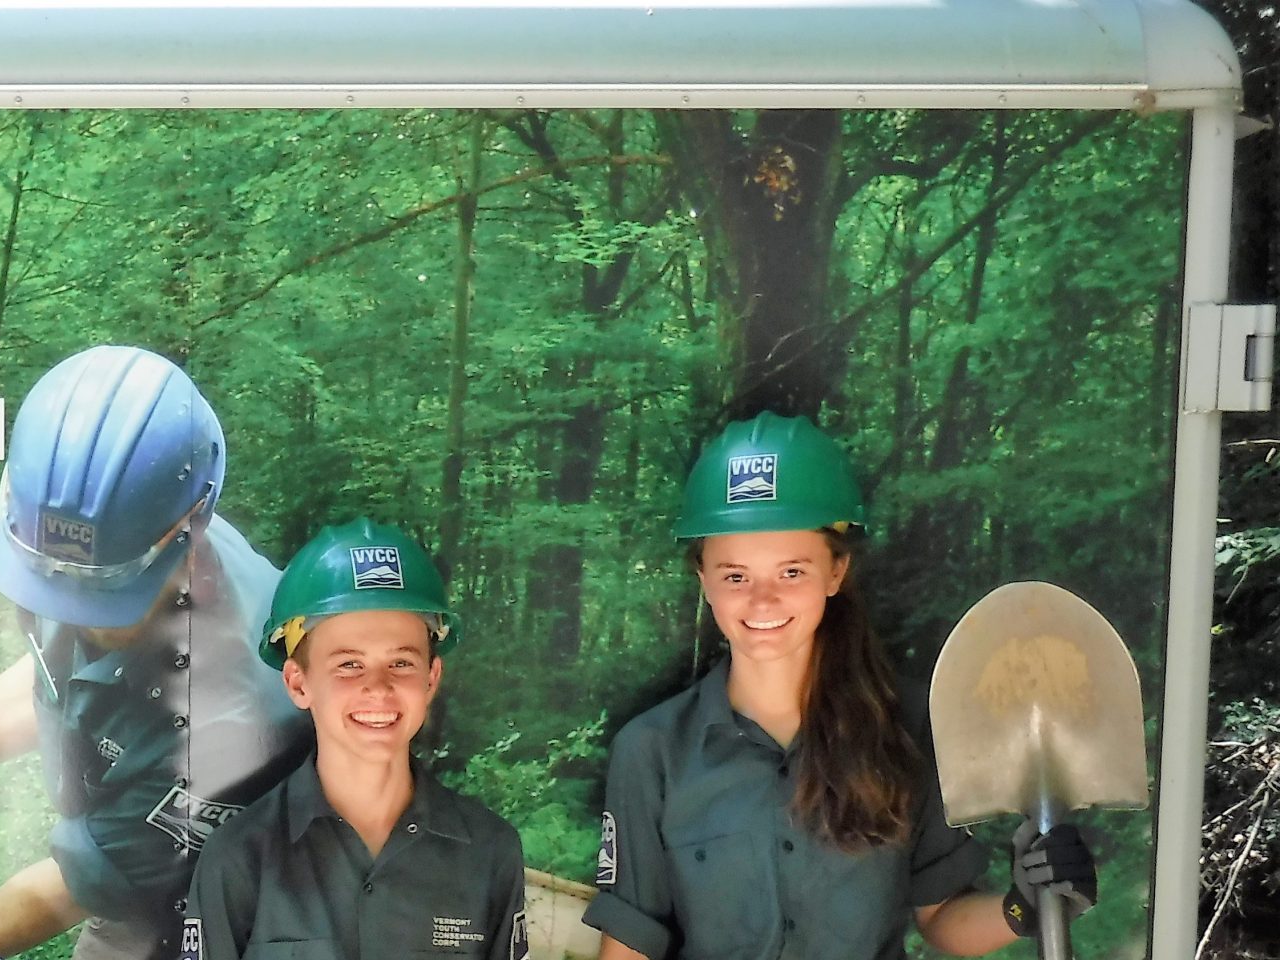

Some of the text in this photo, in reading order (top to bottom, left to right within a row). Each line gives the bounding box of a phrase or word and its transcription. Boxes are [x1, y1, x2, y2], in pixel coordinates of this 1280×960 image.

[732, 457, 773, 475] VYCC
[46, 517, 92, 544] VYCC
[354, 549, 396, 563] VYCC
[433, 917, 471, 926] VERMONT
[433, 924, 460, 932] YOUTH
[432, 938, 460, 947] CORPS
